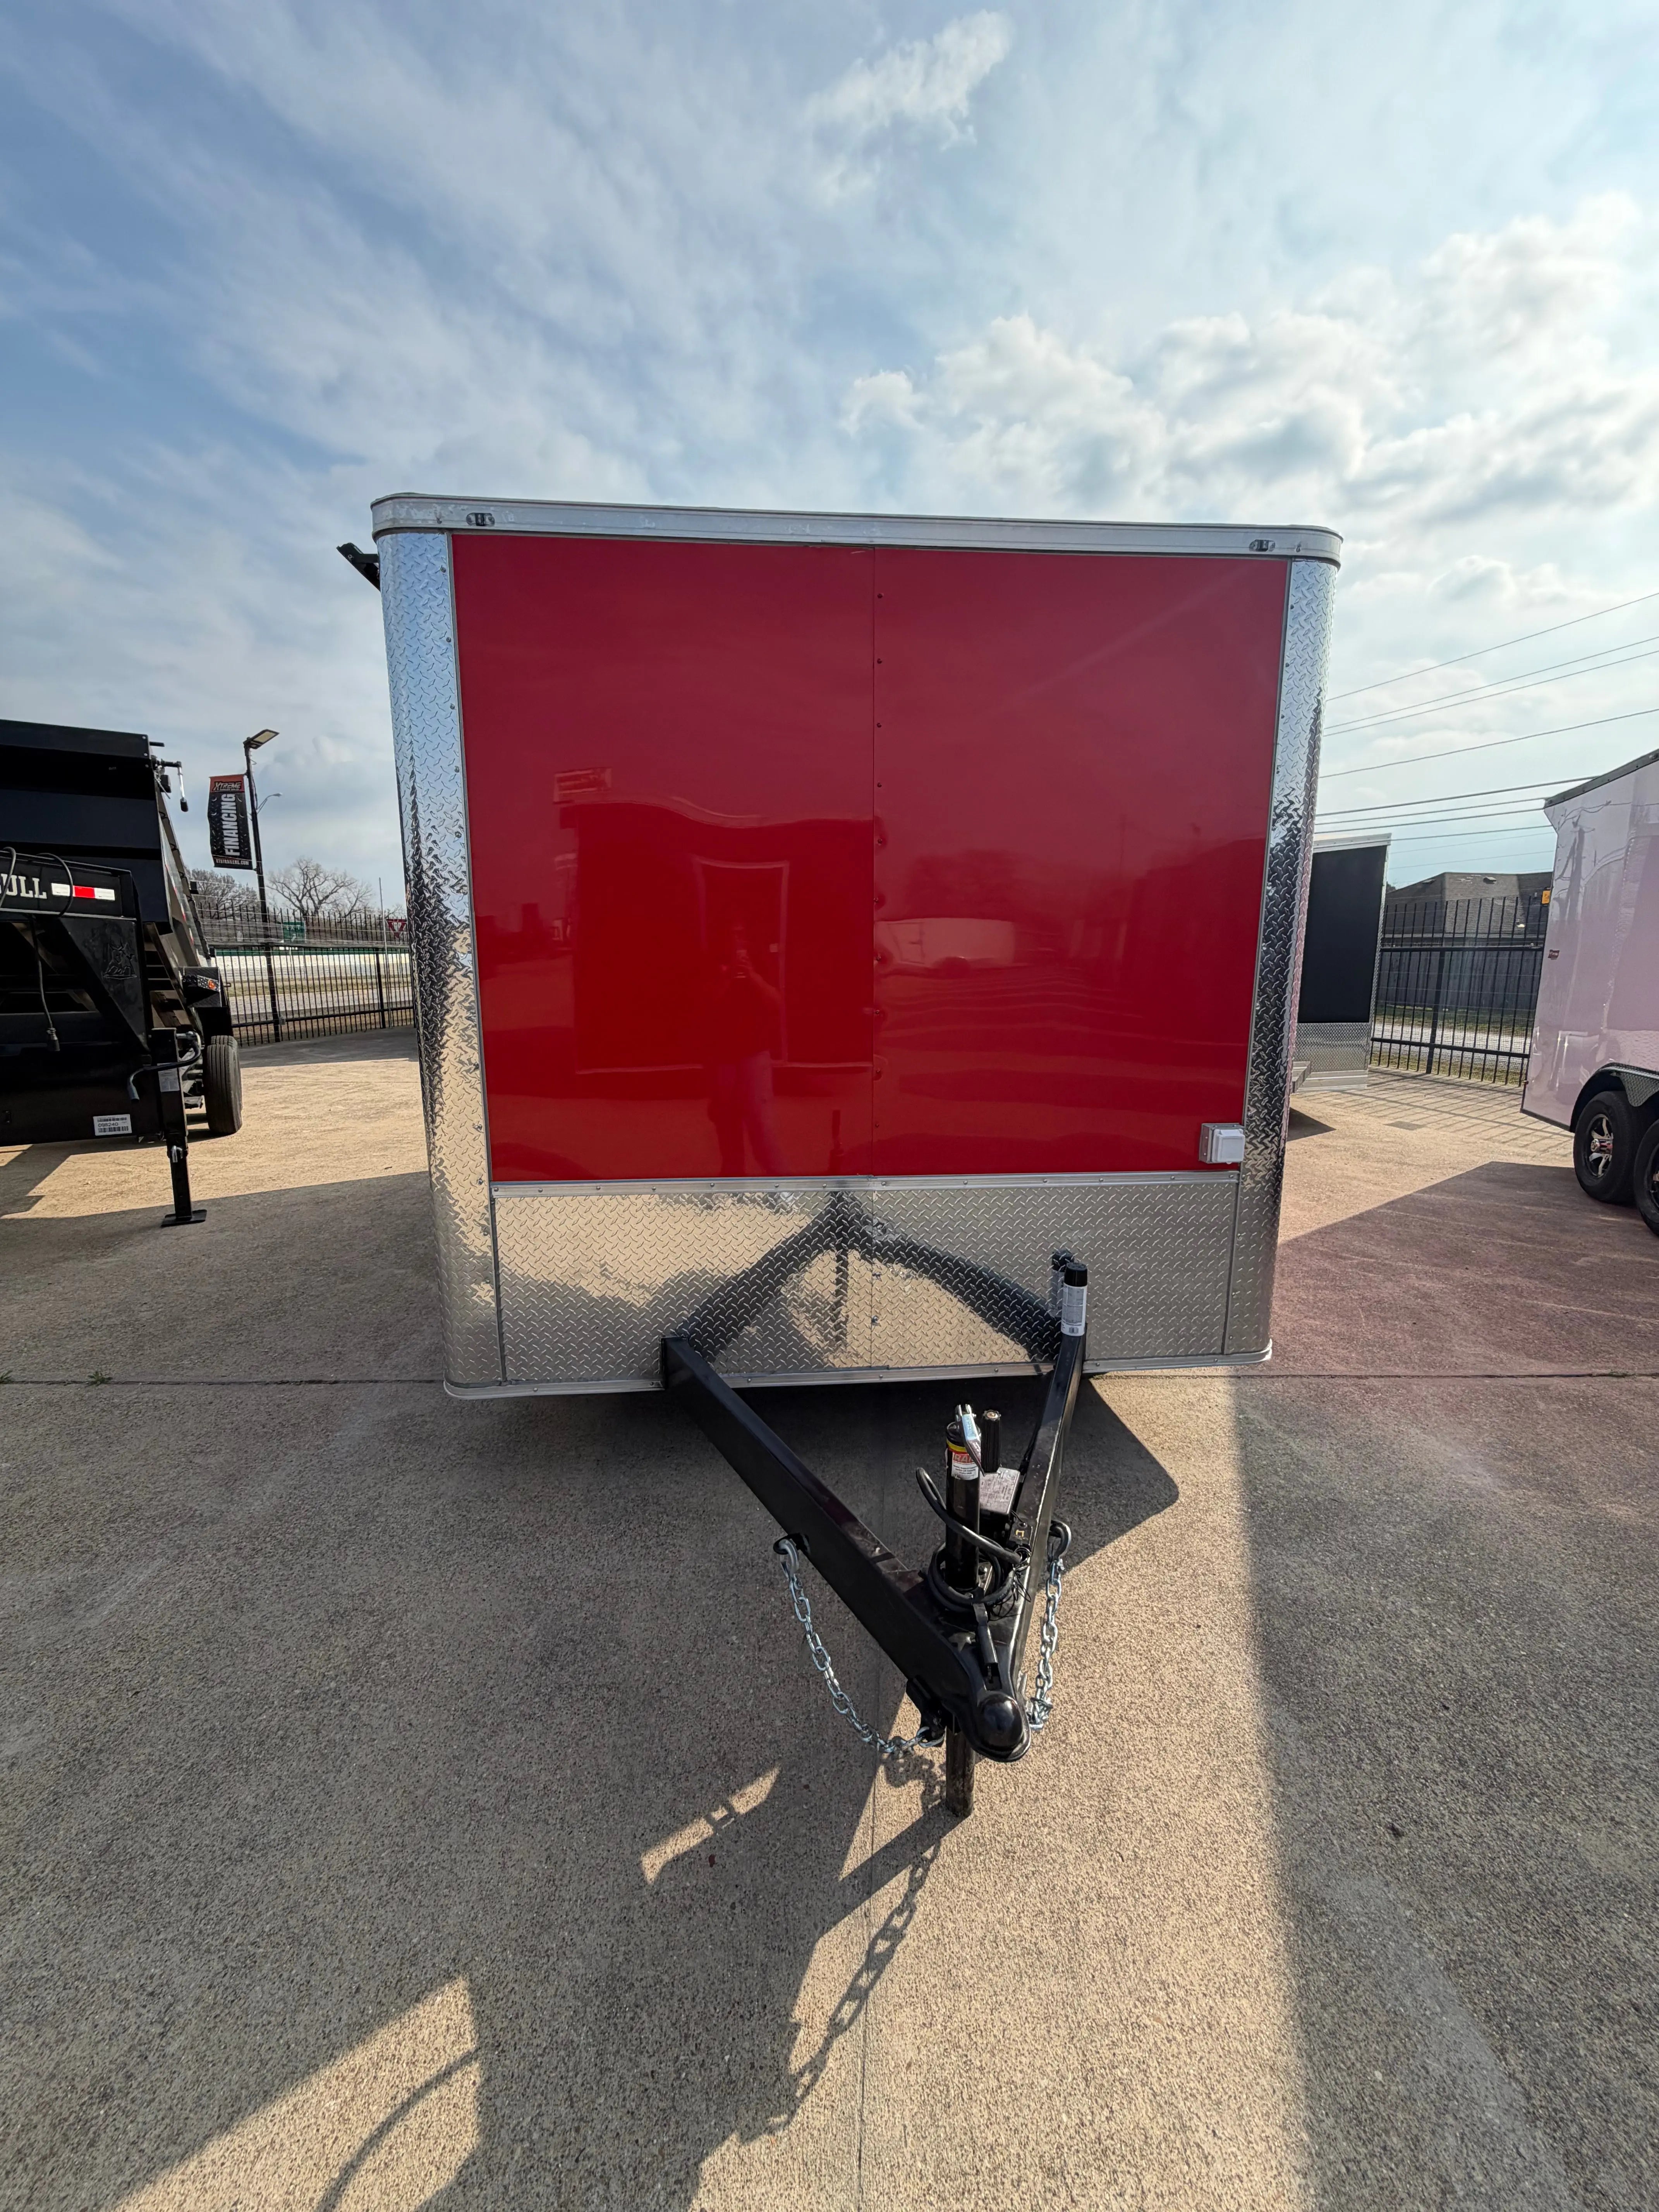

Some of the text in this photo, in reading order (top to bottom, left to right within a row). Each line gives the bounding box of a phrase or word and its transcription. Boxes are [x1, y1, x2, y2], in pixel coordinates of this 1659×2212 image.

[213, 781, 242, 791] XTREME
[221, 794, 240, 856] FINANCING
[0, 873, 47, 899] ULL
